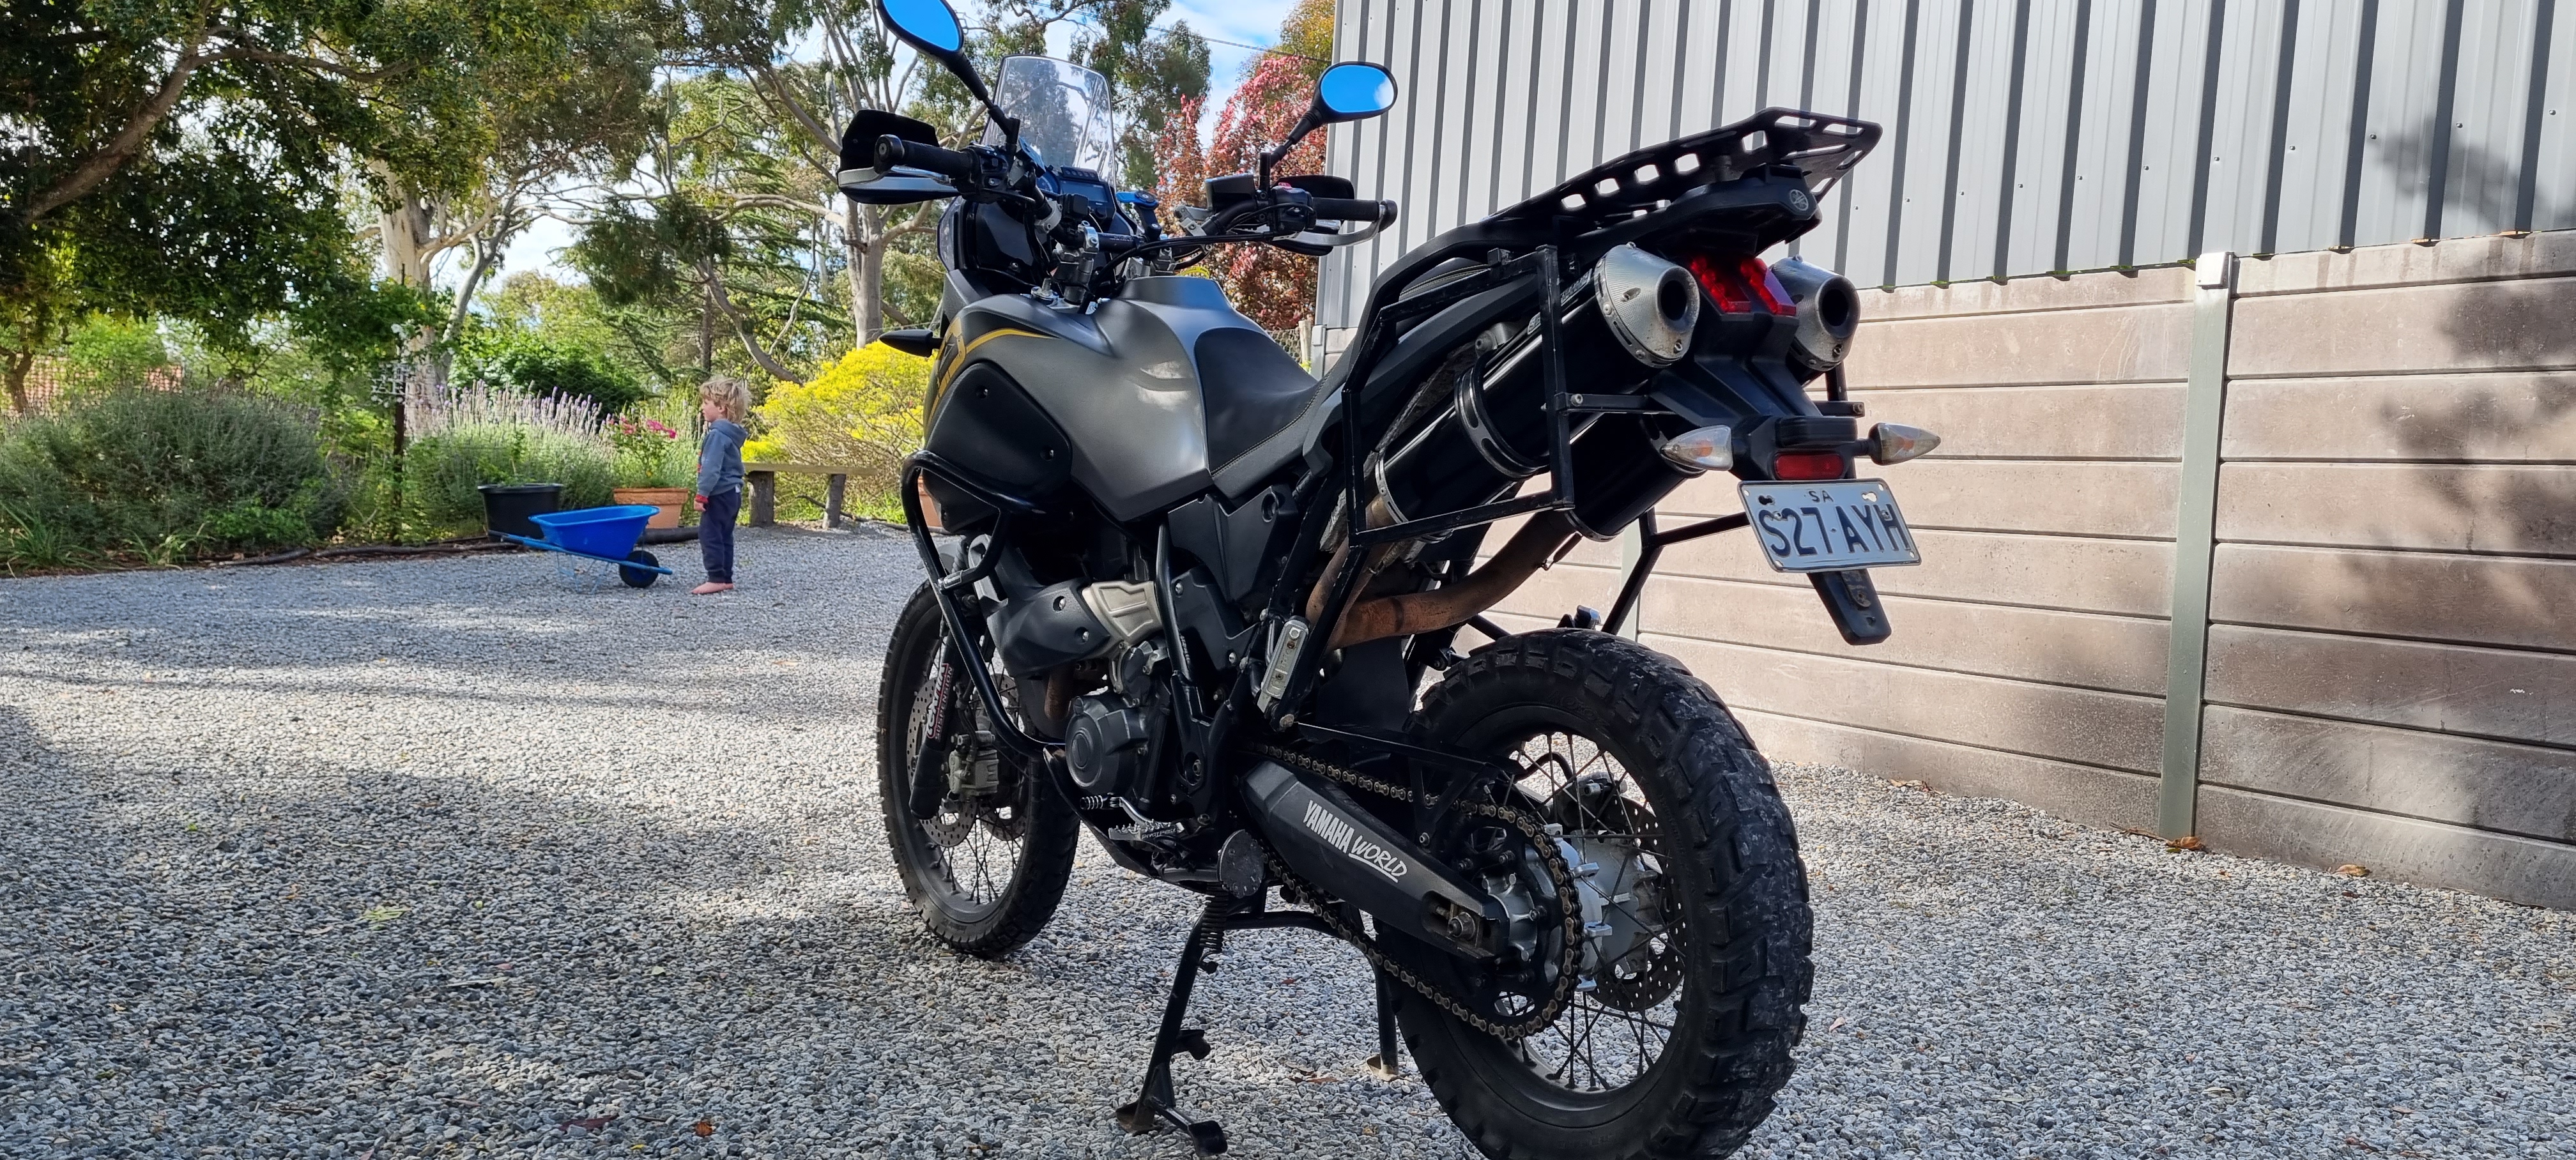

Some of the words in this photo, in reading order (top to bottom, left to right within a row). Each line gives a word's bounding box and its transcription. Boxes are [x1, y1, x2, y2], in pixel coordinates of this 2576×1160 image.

[1809, 491, 1833, 503] SA
[935, 666, 953, 740] SUSPENSION
[1303, 800, 1354, 853] YAMAHA
[1350, 835, 1407, 879] WORLD
